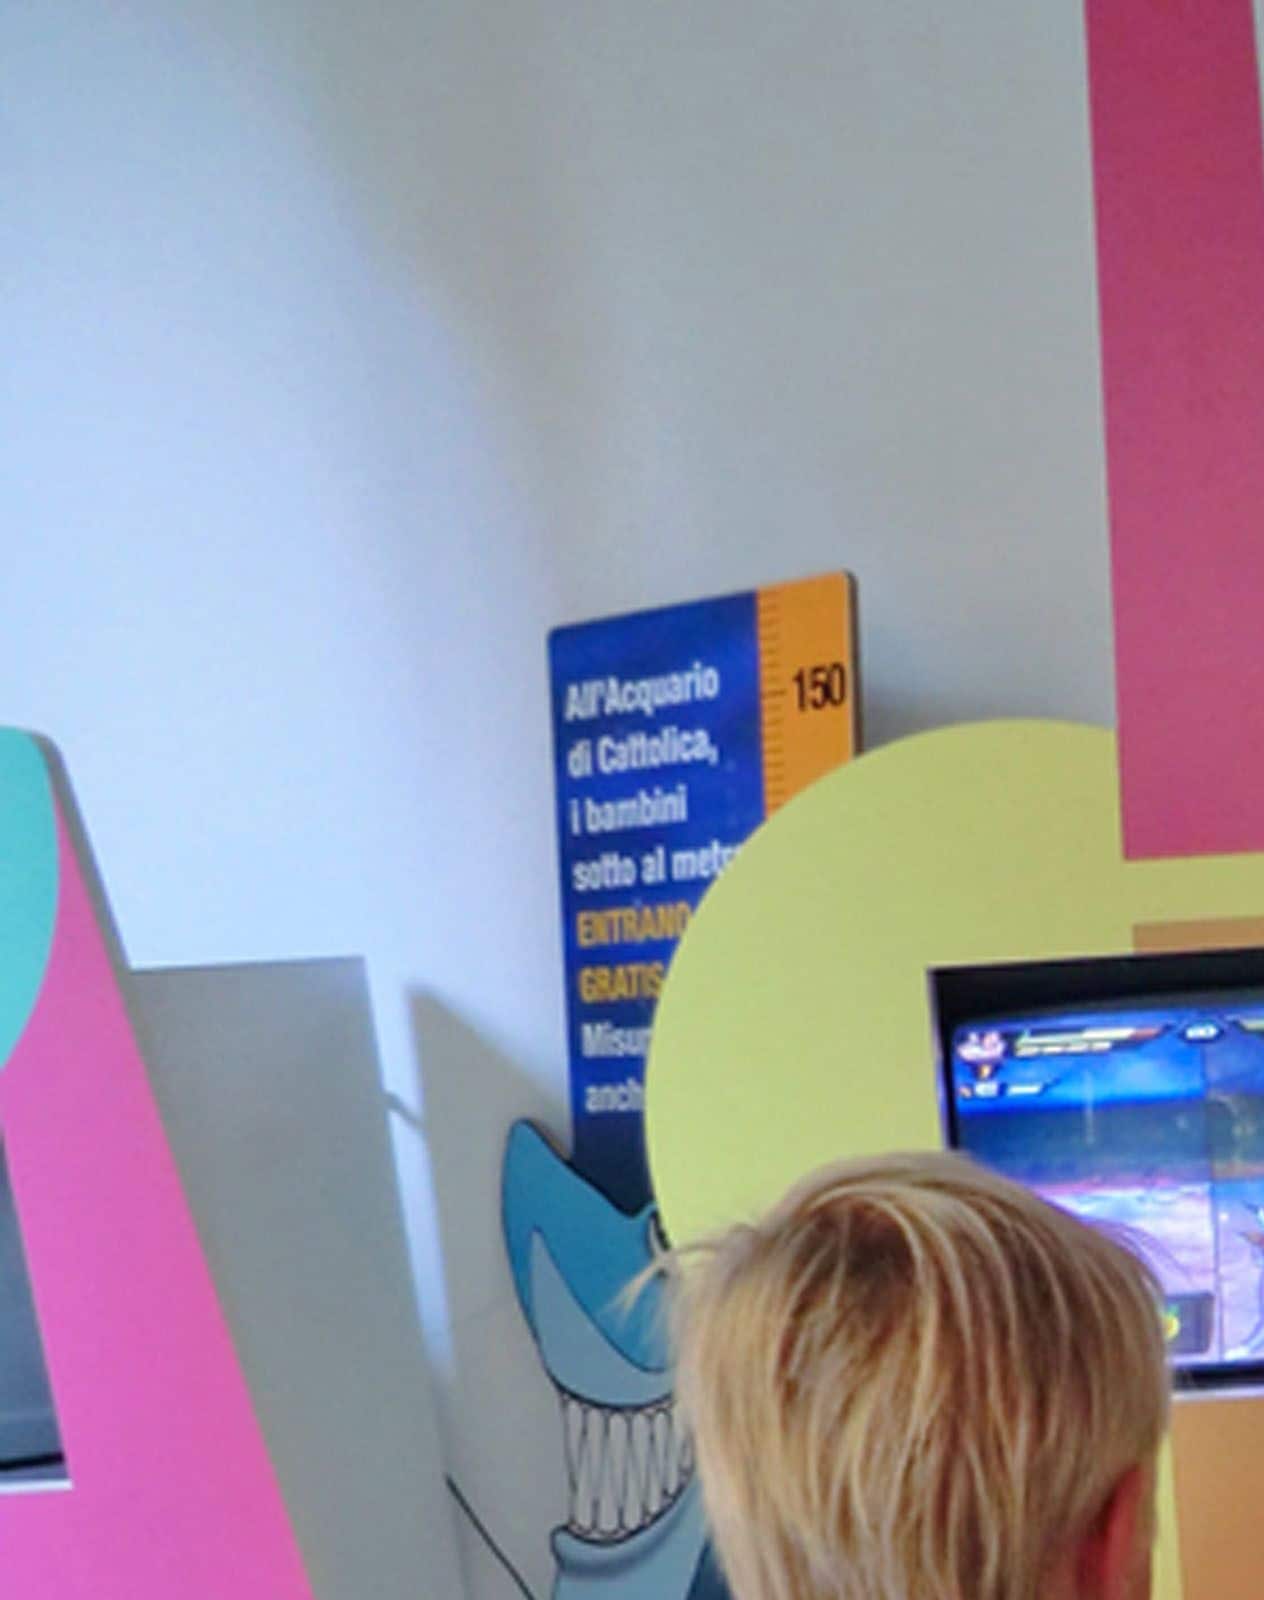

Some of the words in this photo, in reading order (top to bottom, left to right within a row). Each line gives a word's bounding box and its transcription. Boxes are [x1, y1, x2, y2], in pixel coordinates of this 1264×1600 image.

[565, 661, 718, 720] All'Acquario
[793, 663, 845, 711] 150
[569, 740, 592, 778] di
[598, 726, 718, 772] Cattolica,
[585, 784, 687, 832] bambini
[573, 855, 636, 891] sotto
[642, 847, 665, 884] al
[673, 840, 741, 880] metr
[579, 963, 664, 1002] GRATIS
[582, 1021, 651, 1057] Misur
[585, 1072, 644, 1112] anch
